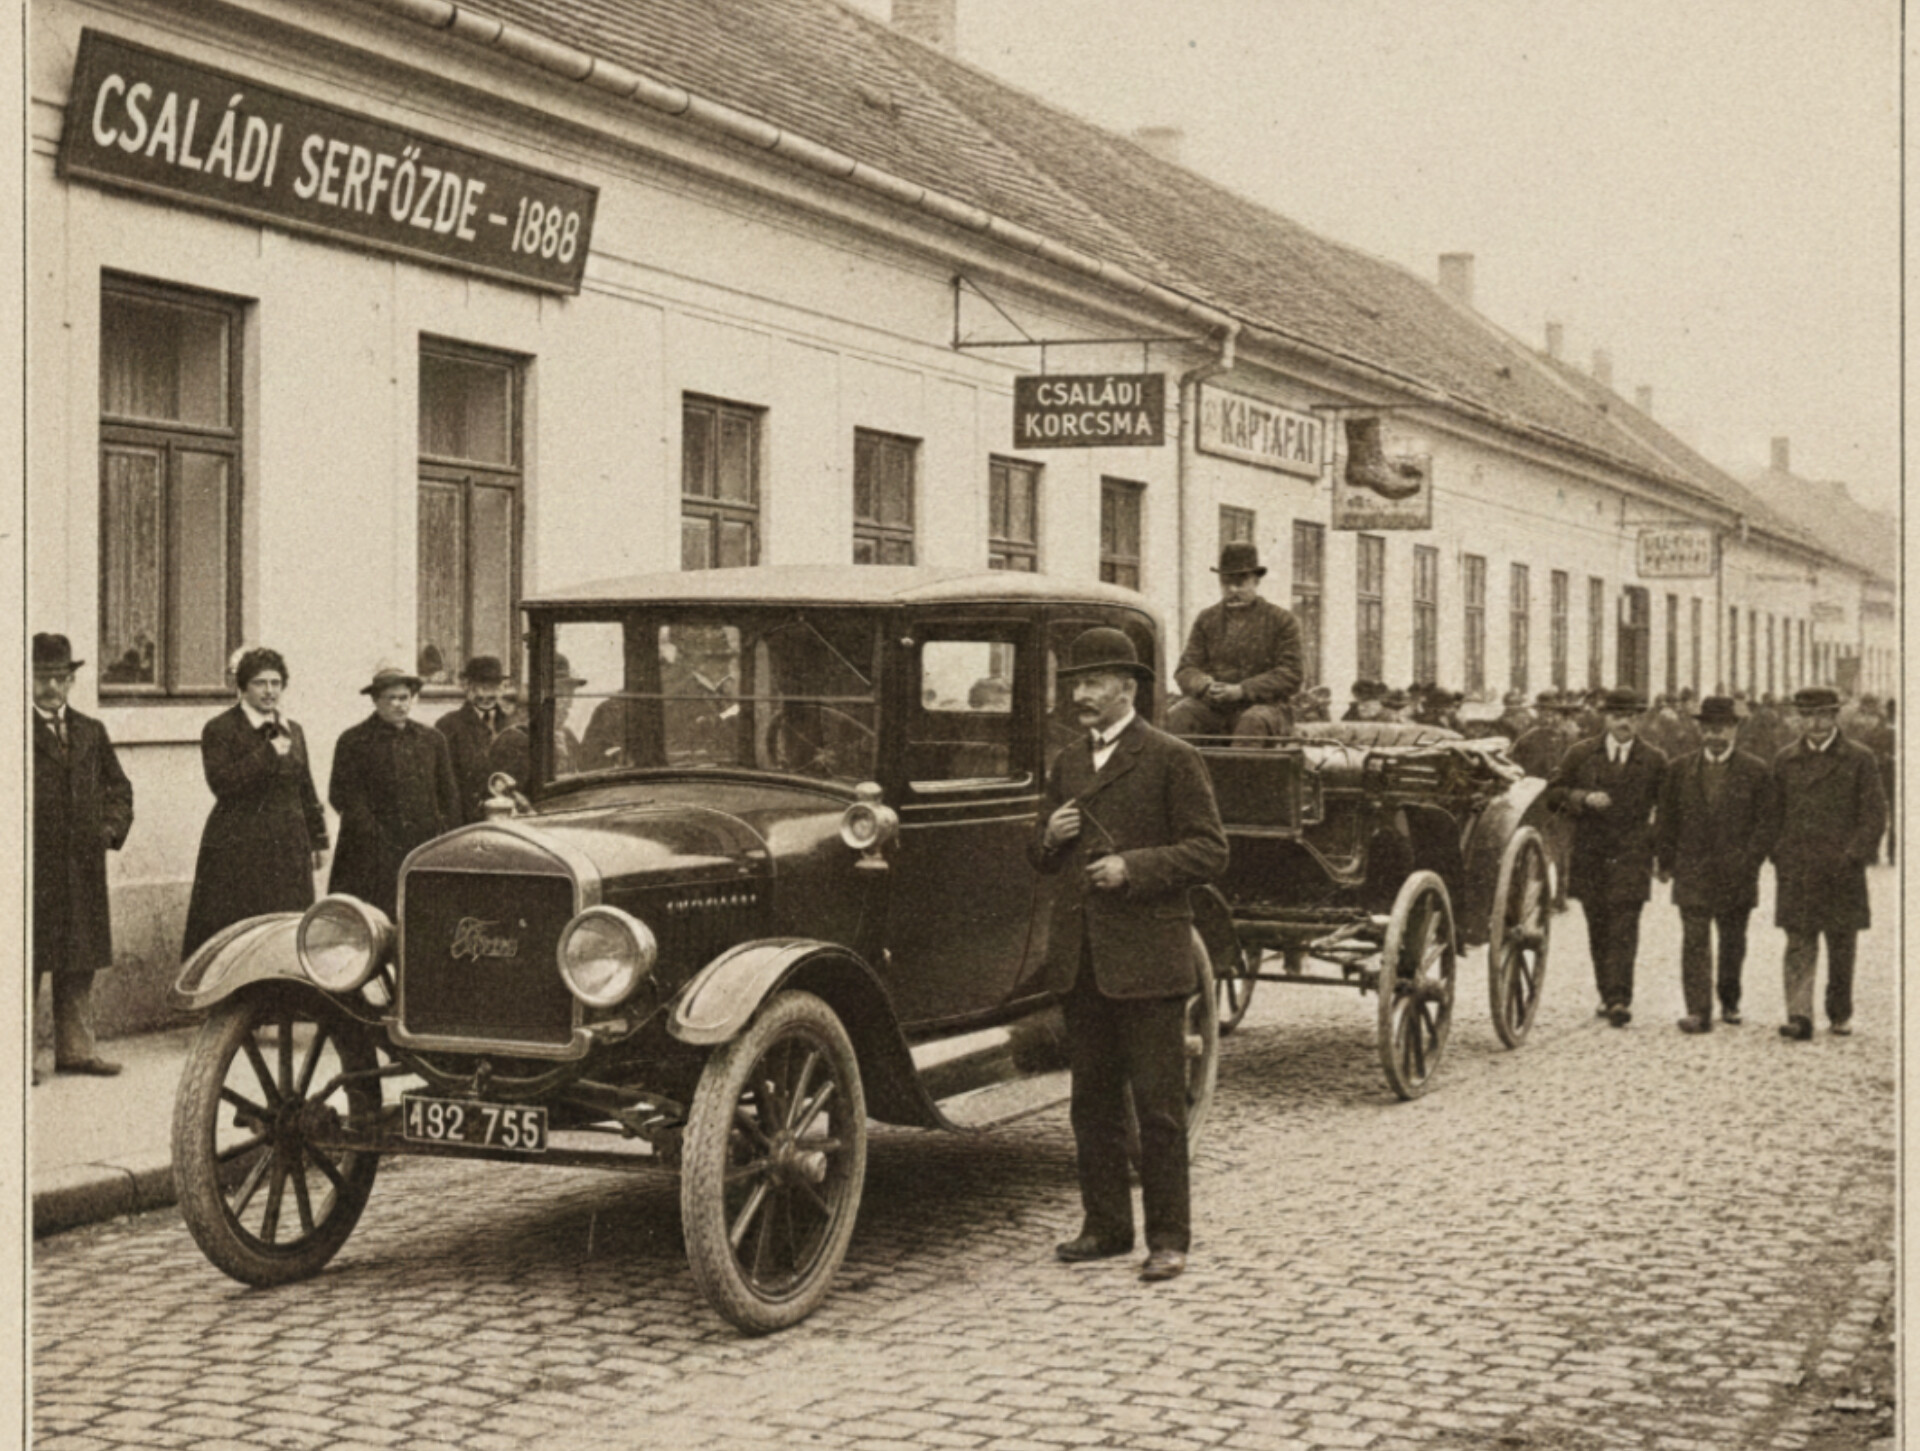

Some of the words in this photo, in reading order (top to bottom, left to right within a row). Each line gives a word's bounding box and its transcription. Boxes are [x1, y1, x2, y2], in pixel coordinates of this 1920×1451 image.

[92, 74, 283, 187] CSALÁDI
[294, 134, 485, 241] SERFŐZDE
[511, 198, 581, 263] 1888
[1037, 377, 1142, 406] CSALÁDI
[1025, 411, 1153, 437] KORCSMA
[481, 1107, 540, 1149] 755
